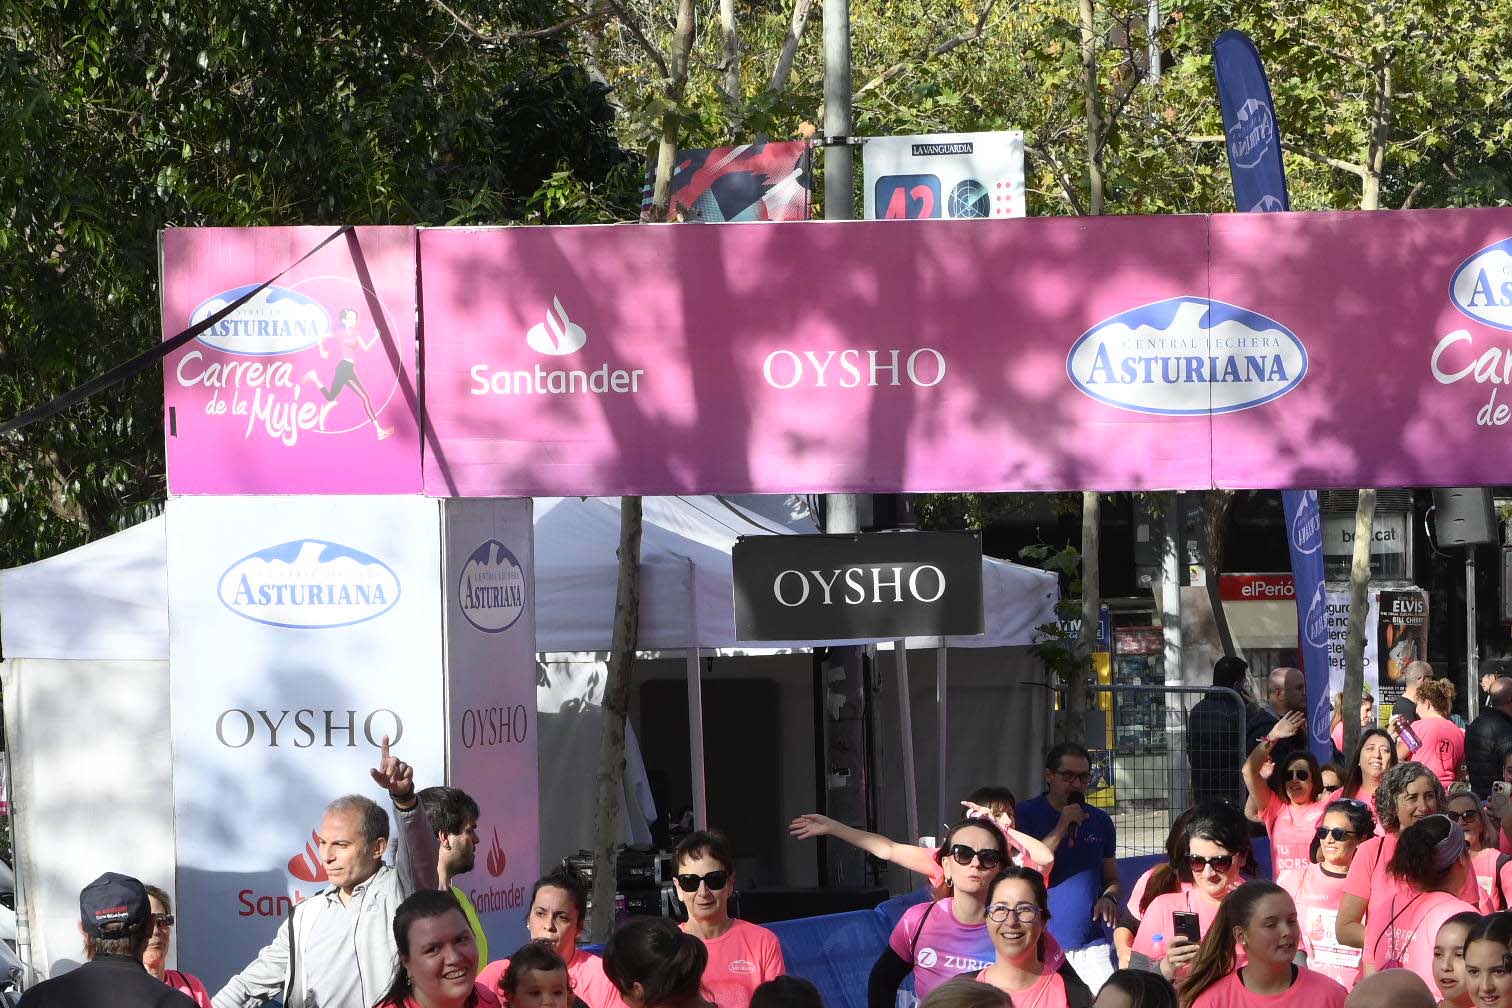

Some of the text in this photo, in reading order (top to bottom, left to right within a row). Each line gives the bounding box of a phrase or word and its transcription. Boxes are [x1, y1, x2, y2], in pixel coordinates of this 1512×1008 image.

[1206, 336, 1281, 349] LECHERA
[176, 350, 293, 388] Carrera
[470, 363, 644, 397] Santander
[763, 348, 946, 389] OYSHO
[1085, 342, 1290, 385] ASTURIANA
[205, 385, 339, 447] de la Mujer
[1475, 385, 1512, 427] de
[233, 573, 387, 606] ASTURIANA
[464, 574, 522, 610] ASTURIANA
[773, 564, 947, 608] OYSHO
[1392, 600, 1424, 613] ELVIS
[215, 709, 404, 748] OYSHO
[461, 705, 527, 748] OYSHO
[1438, 741, 1451, 753] 21
[470, 885, 525, 914] Santander
[943, 955, 996, 972] ZURIC
